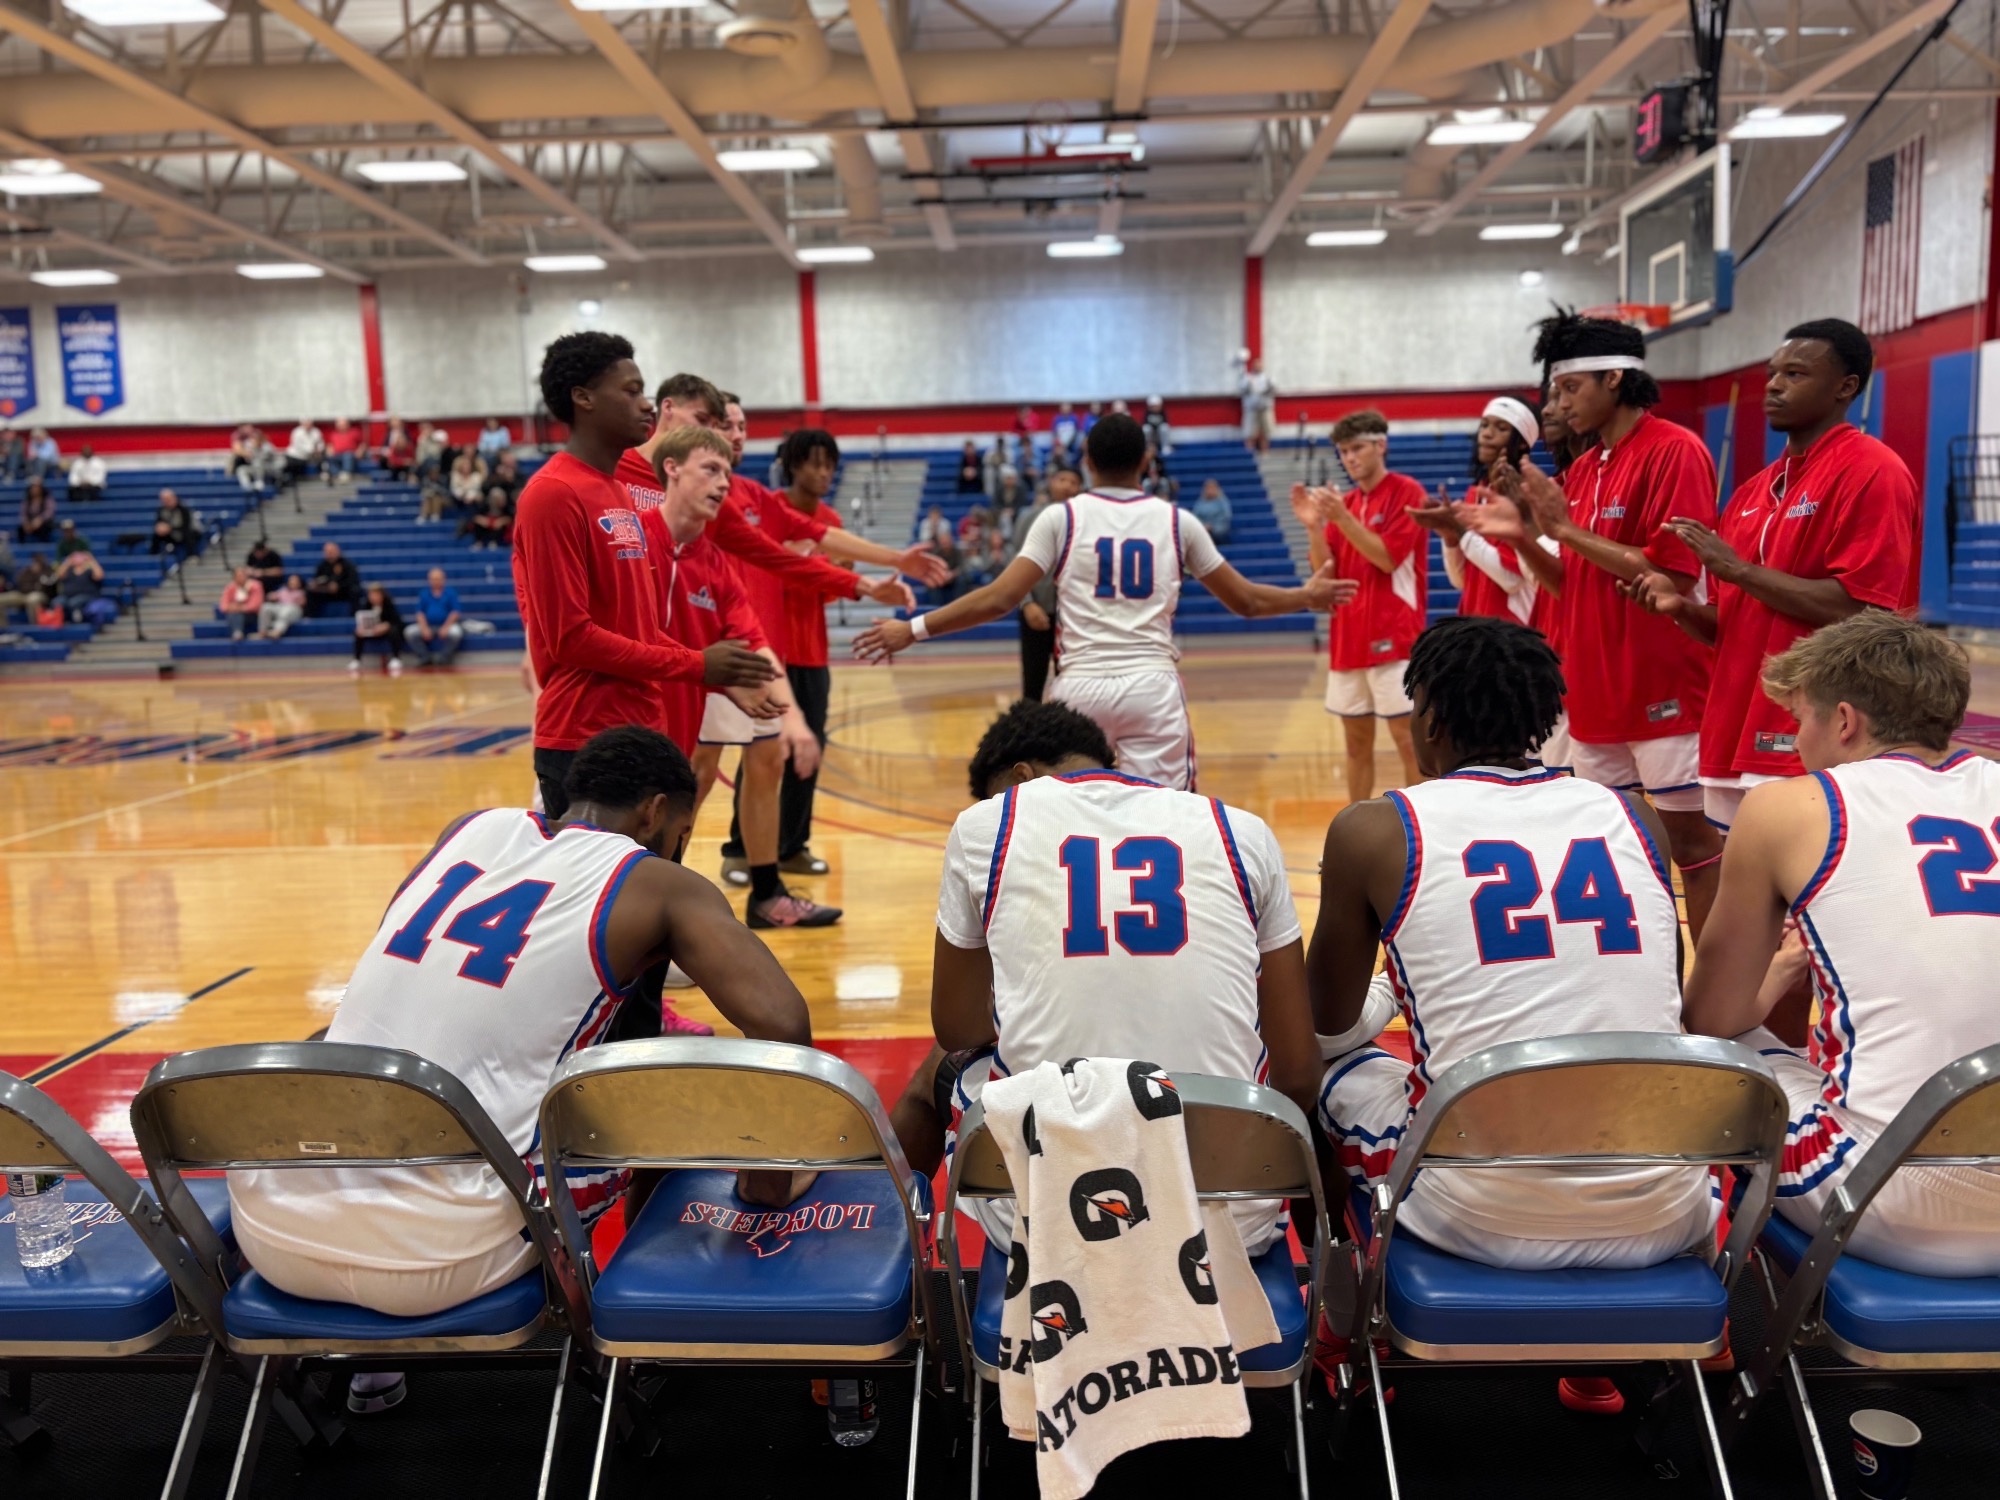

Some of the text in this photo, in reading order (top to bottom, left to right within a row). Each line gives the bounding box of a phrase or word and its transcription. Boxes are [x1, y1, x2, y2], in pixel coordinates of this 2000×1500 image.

[1094, 536, 1154, 599] 10
[1059, 835, 1188, 958] 13
[1461, 836, 1642, 965] 24
[1906, 813, 2000, 917] 2
[383, 860, 556, 989] 14
[680, 1201, 877, 1234] LOGGERS
